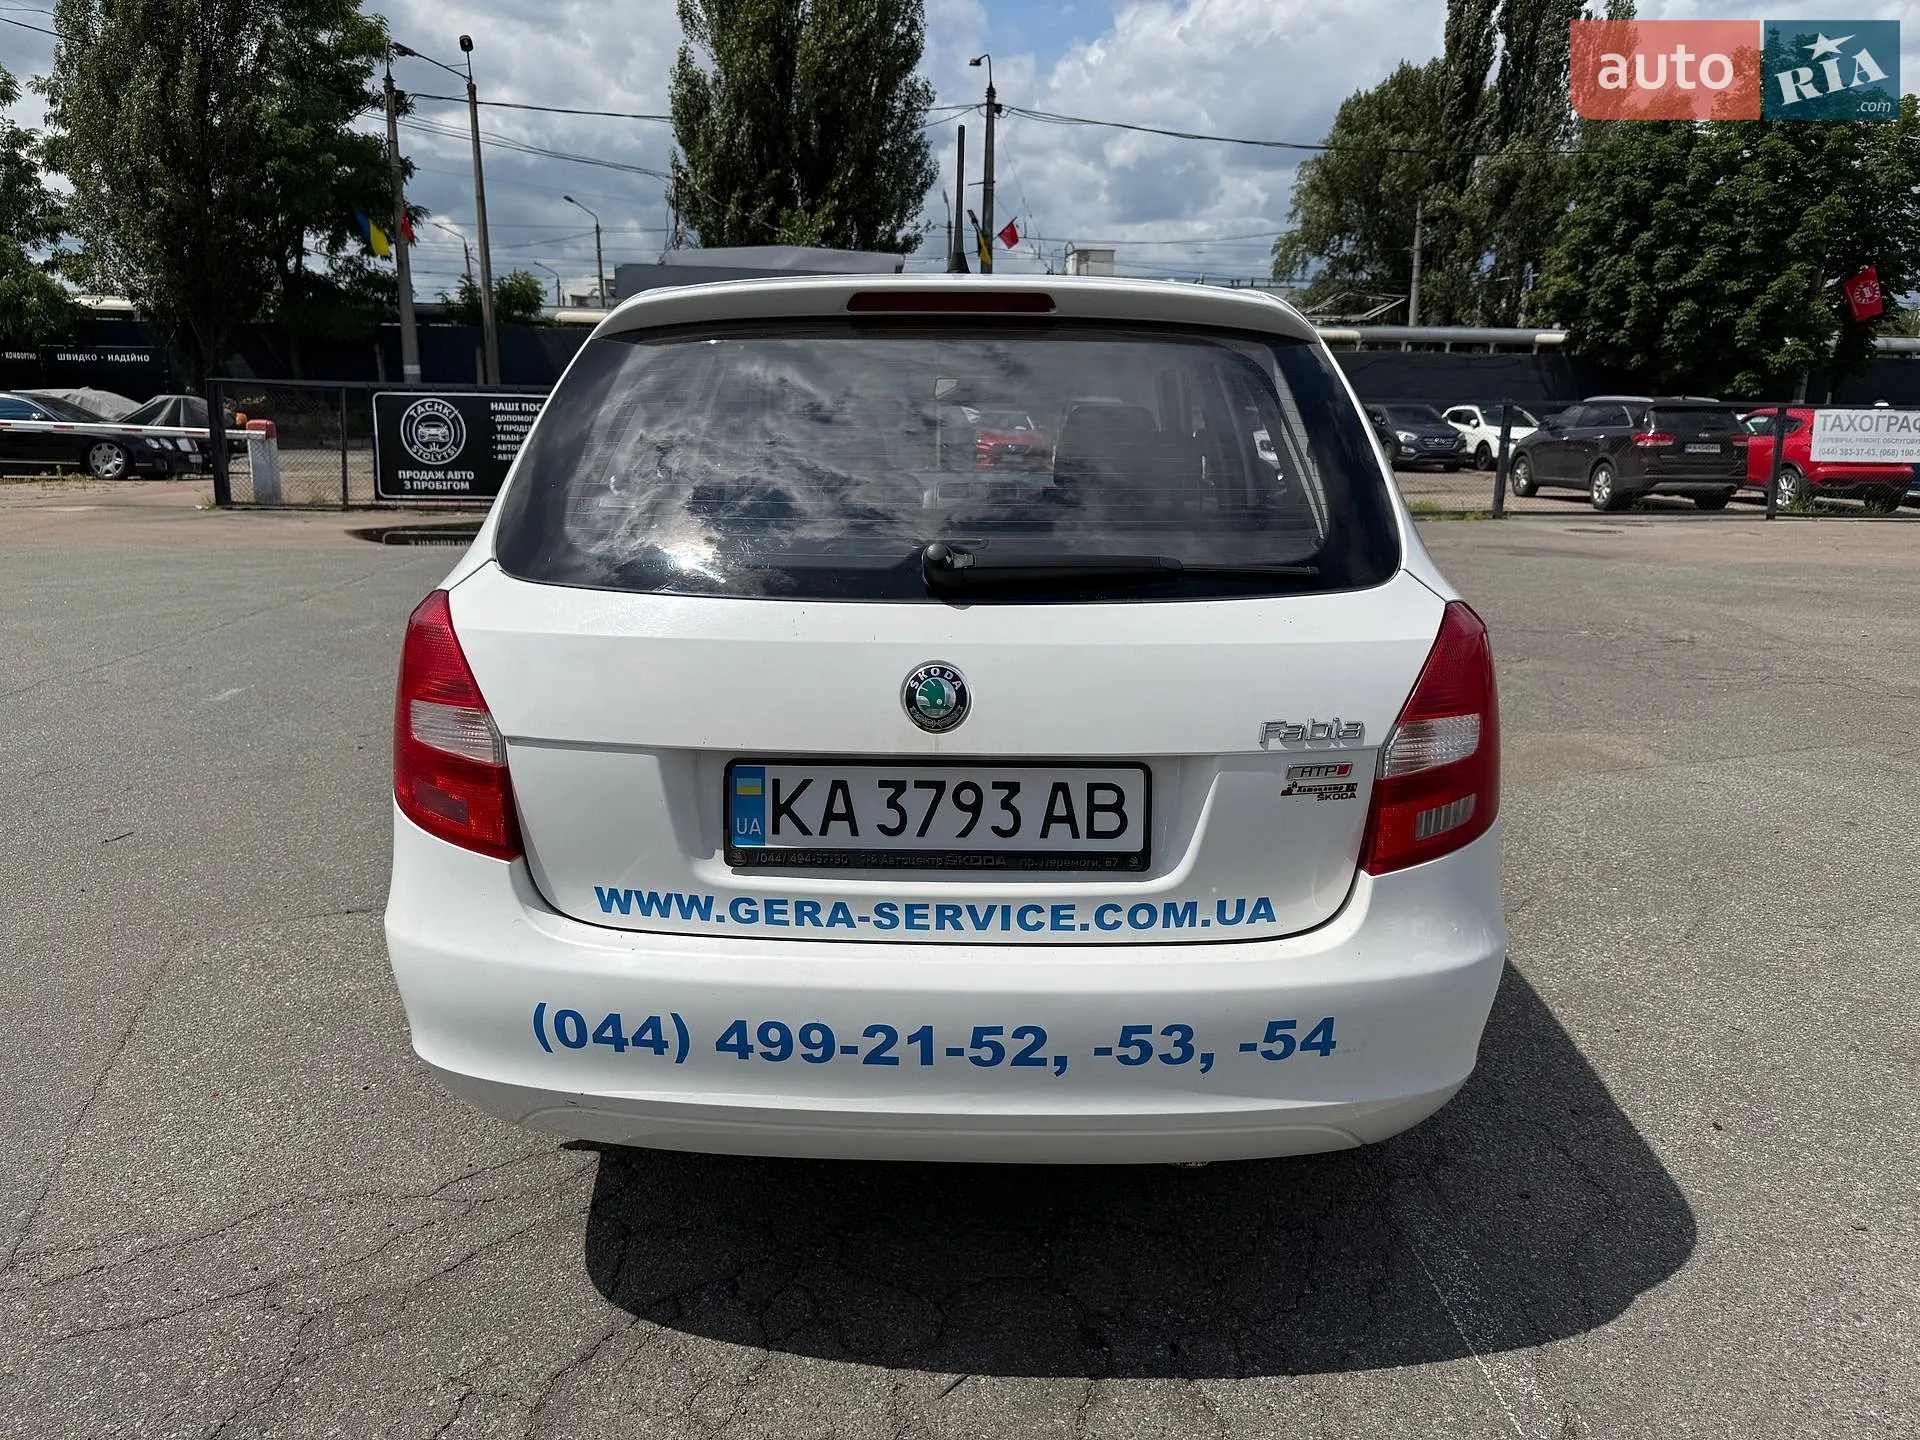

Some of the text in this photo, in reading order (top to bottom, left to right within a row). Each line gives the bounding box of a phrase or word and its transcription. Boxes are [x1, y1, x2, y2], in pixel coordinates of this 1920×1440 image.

[56, 353, 150, 363] ШВИДКО НАДІЙНО
[409, 401, 459, 420] TACHKI
[490, 402, 520, 412] НАШІ
[398, 470, 475, 481] ПРОДАЖ АВТО
[414, 480, 470, 491] ПРОБІГОМ
[1259, 718, 1364, 744] Fabia
[770, 778, 1130, 840] KA 3793 AB
[736, 818, 762, 836] UA
[594, 886, 1277, 932] WWW.GERA-SERVICE.COM.UA
[533, 1002, 1336, 1077] (044) 499-21-52, -53, -54
